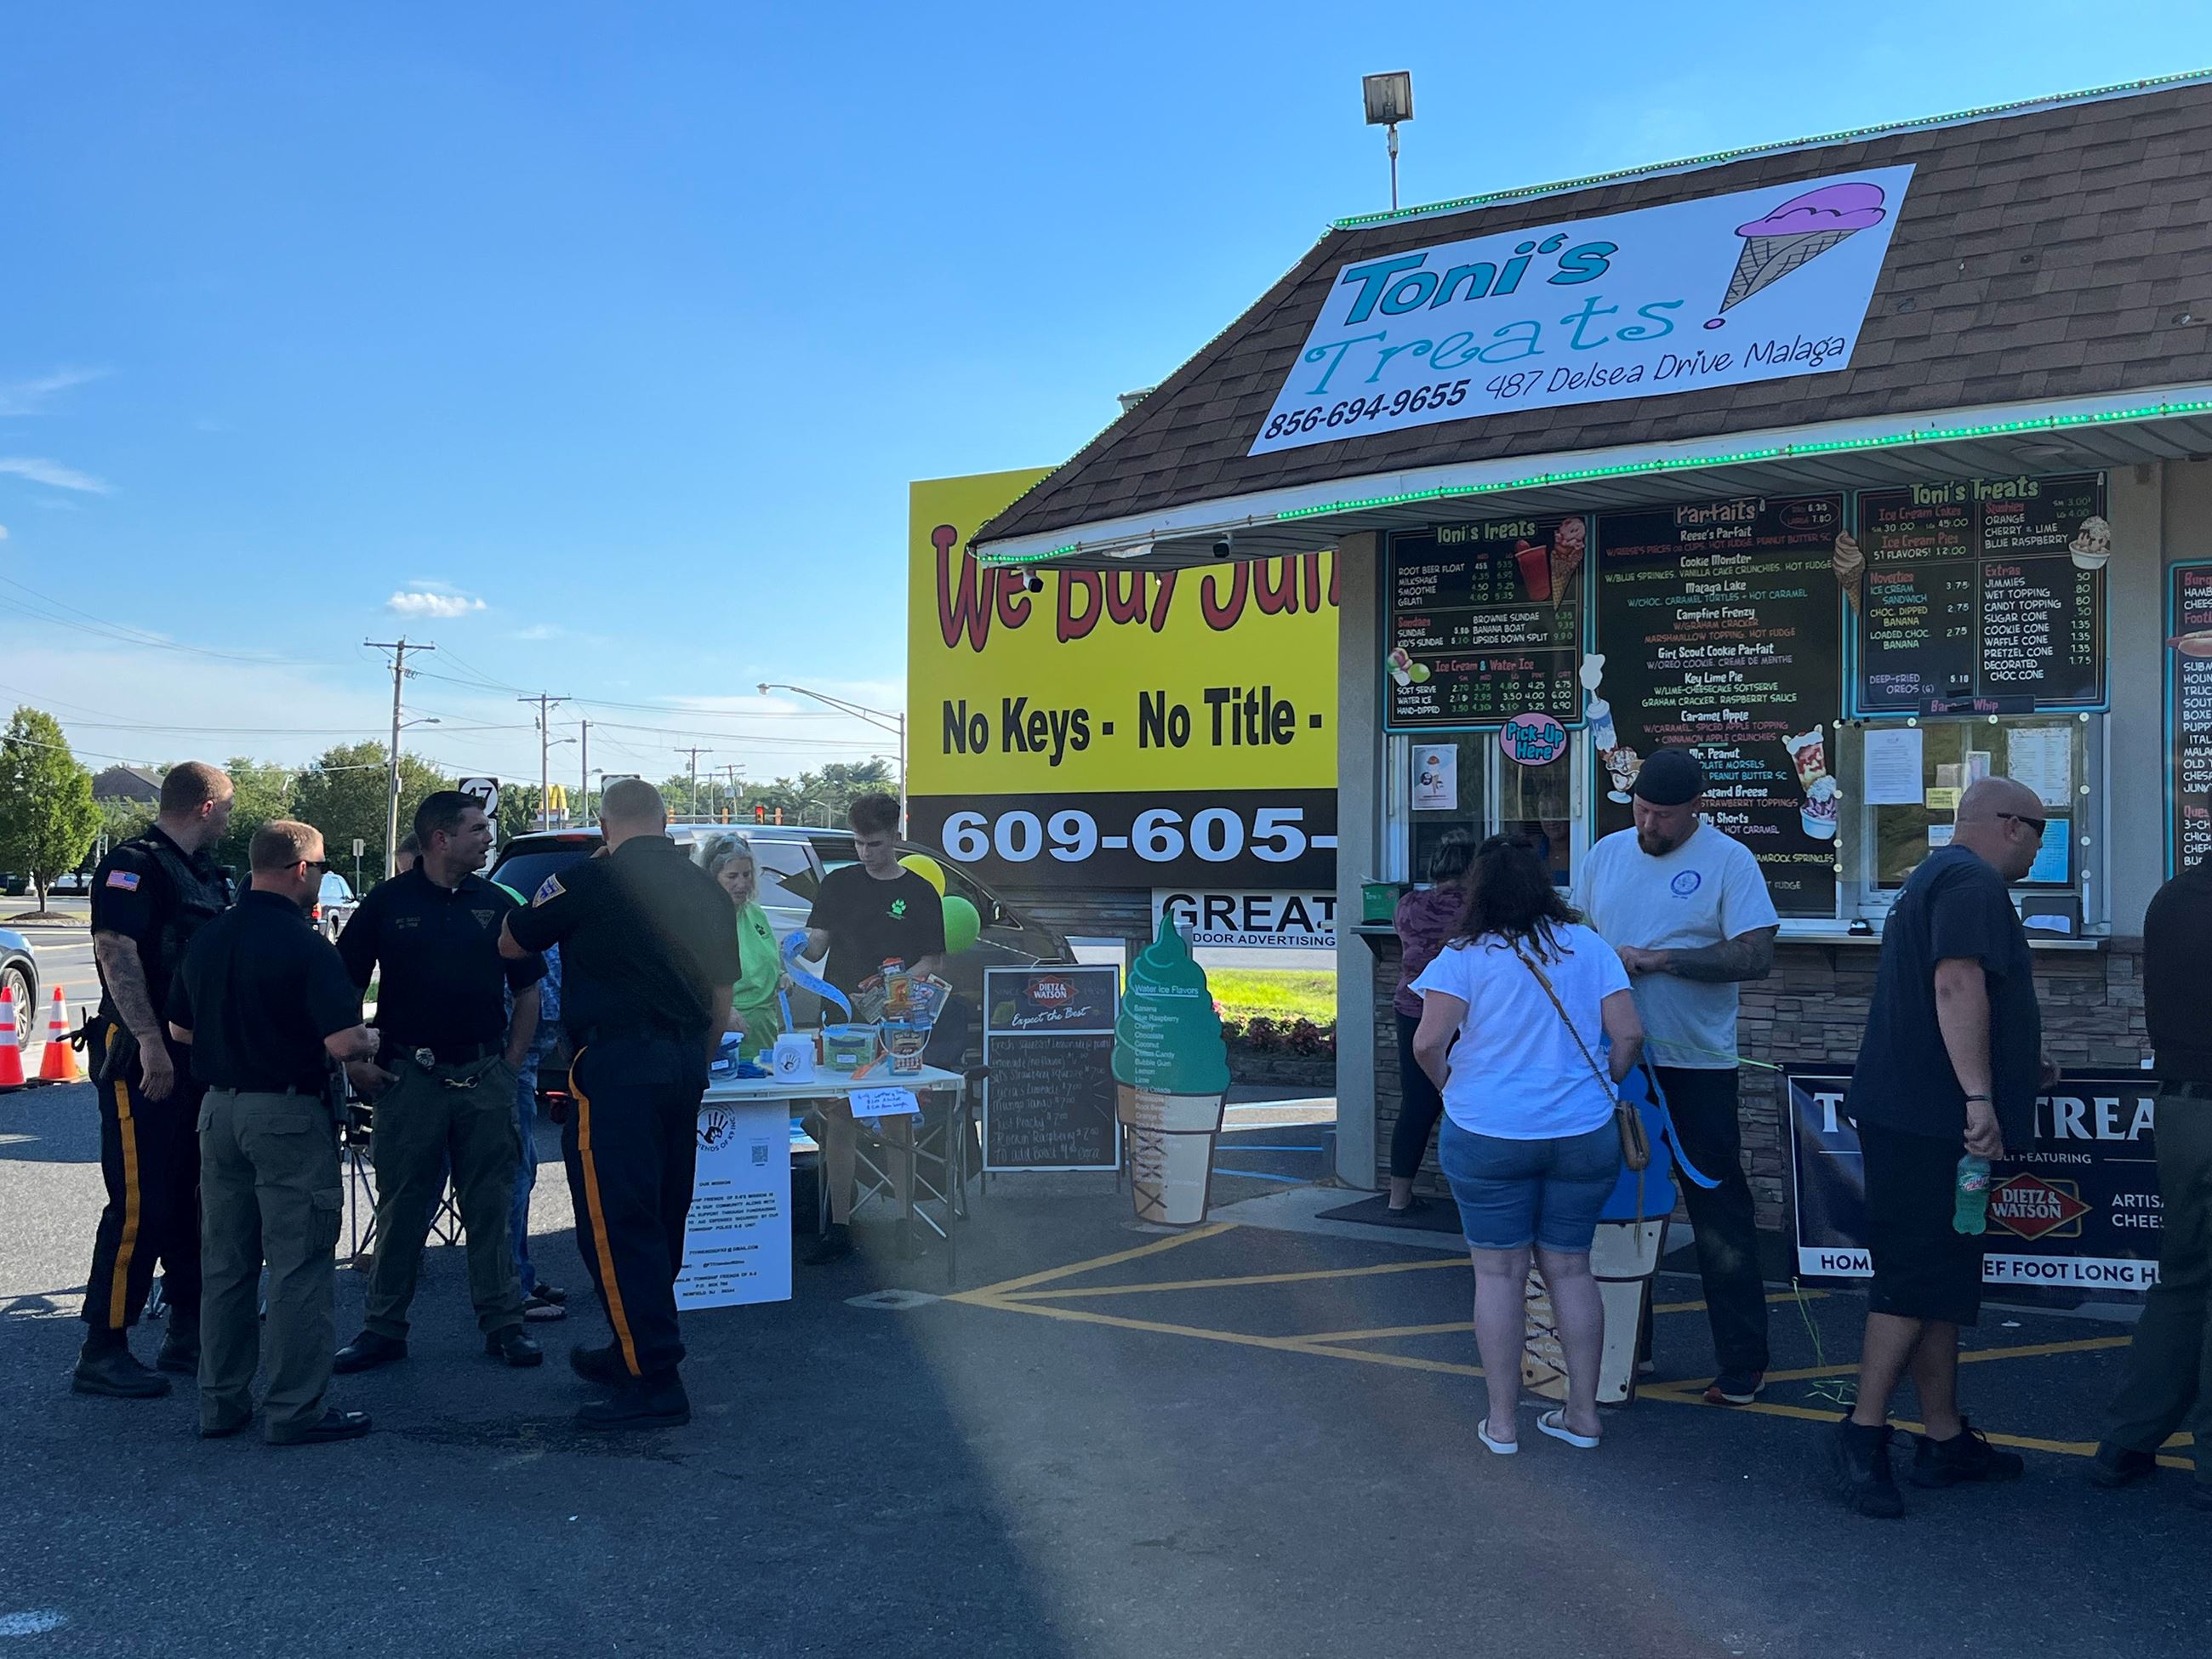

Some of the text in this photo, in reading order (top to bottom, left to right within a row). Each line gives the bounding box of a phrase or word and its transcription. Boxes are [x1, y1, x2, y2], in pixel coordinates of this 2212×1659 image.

[1305, 296, 1685, 395] Treats
[1264, 333, 1846, 442] 856-694-9655 487 Delsea Drive Malaga
[1912, 476, 2039, 505] Toni's Treats
[1878, 505, 1961, 521] Ice Cream Cakes
[1985, 514, 2025, 524] ORANGE
[1680, 527, 1752, 542] Reese's Parfait
[1985, 524, 2057, 536] CHERRY LIME
[1882, 533, 1958, 548] Ice Cream Pies
[1985, 534, 2068, 548] BLUE RASPBERRY
[1887, 548, 1931, 559] FLAVORS!
[1680, 555, 1751, 568] Cookie Monster
[1442, 564, 1465, 573] FLOAT
[1986, 566, 2021, 577] Extras
[1399, 576, 1437, 585] MILKSHAKE
[1985, 578, 2025, 588] JIMMIES
[932, 524, 1032, 653] We
[1398, 586, 1436, 596] SMOOTHIE
[1685, 581, 1746, 596] Malaga Lake
[1985, 588, 2050, 599] WET TOPPING
[1398, 598, 1422, 607] GELATI
[1984, 600, 2061, 612] CANDY TOPPING
[1677, 607, 1755, 622] Campfire Frenzy
[1899, 607, 1928, 616] DIPPED
[1473, 613, 1539, 624] BROWNIE SUNDAE
[1884, 618, 1919, 627] BANANA
[1984, 612, 2047, 623] SUGAR CONE
[1504, 624, 1525, 632] BOAT
[1984, 621, 2090, 635] COOKIE CONE 1.35
[1473, 636, 1499, 644] UPSIDE
[1527, 633, 1548, 641] SPLIT
[1870, 630, 1902, 640] LOADED
[1397, 639, 1416, 647] KID'S
[1884, 640, 1919, 650] BANANA
[1984, 638, 2019, 647] WAFFLE
[2021, 636, 2049, 645] CONE
[1658, 643, 1774, 658] Girl Scout Cookie Parfait
[1984, 645, 2090, 658] PRETZEL CONE 1.35
[1435, 658, 1534, 672] Ice Cream & Water Ice
[1984, 660, 2037, 670] DECORATED
[1685, 671, 1742, 685] Key Lime Pie
[1870, 674, 1920, 684] DEEP-FRIED
[1990, 670, 2044, 681] CHOC CONE
[1886, 685, 1919, 694] OREOS
[1642, 698, 1676, 707] GRAHAM
[1720, 695, 1768, 704] RASPBERRY
[1770, 693, 1797, 702] SAUCE
[1397, 706, 1440, 715] HAND-DIPPED
[1681, 708, 1748, 722] Caramel Apple
[942, 686, 1296, 767] No Keys No Title
[1507, 722, 1564, 749] Pick-Up
[1517, 744, 1552, 760] Here
[1708, 748, 1740, 759] Peanut
[1726, 761, 1764, 769] MORSELS
[2183, 760, 2204, 768] OLD
[1735, 785, 1768, 797] Breese
[1702, 798, 1798, 807] STRAWBERRY TOPPINGS
[1717, 812, 1748, 824] Shorts
[941, 807, 1337, 862] 609-605-
[1793, 854, 1834, 863] SPRINKLES
[1238, 932, 1336, 945] ADVERTISING
[1135, 984, 1156, 993] Water
[1172, 986, 1199, 995] Flavors
[1012, 1006, 1092, 1029] Expect the Best
[1992, 1203, 2061, 1218] WATSON
[2013, 1262, 2068, 1279] FOOT
[2074, 1264, 2135, 1282] LONG
